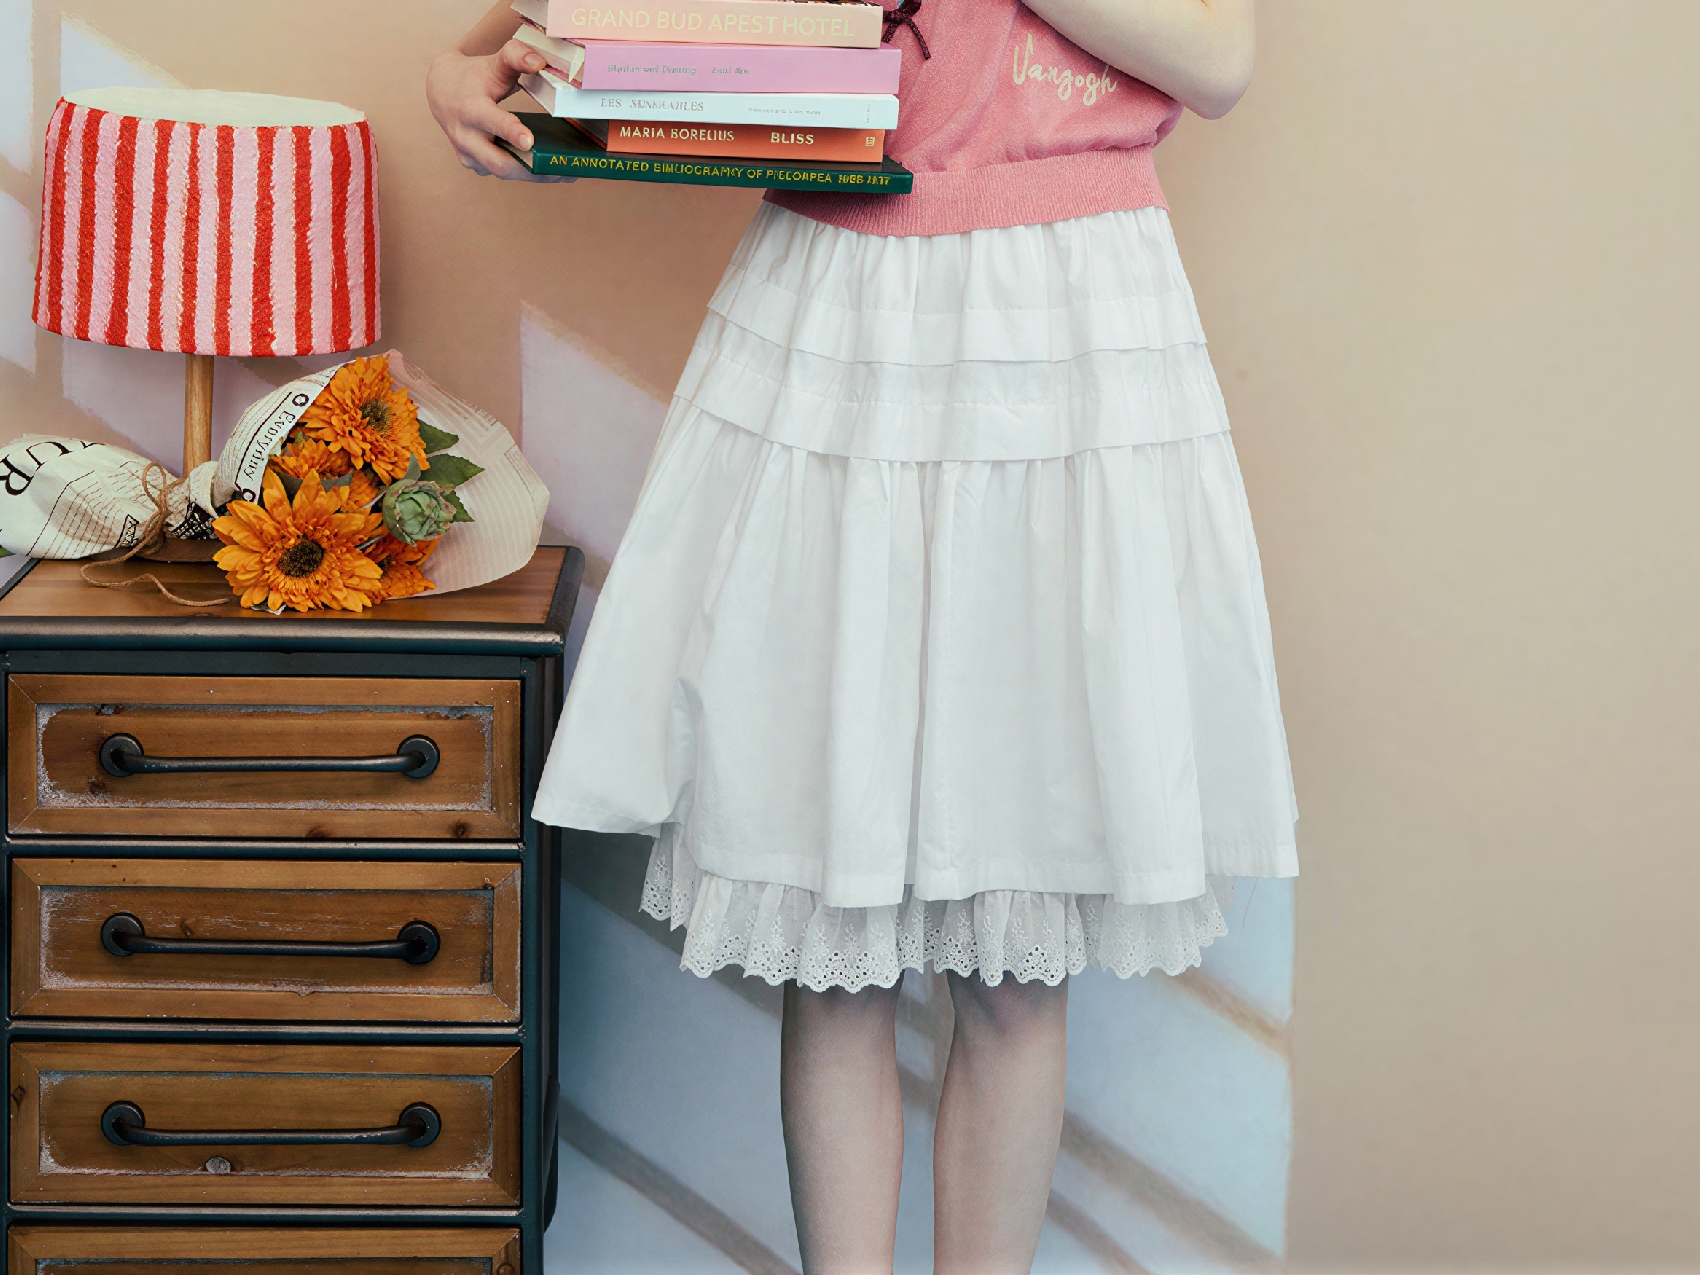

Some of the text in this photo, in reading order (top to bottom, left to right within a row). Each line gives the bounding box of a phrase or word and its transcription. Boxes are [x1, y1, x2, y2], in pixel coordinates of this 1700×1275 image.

[571, 7, 653, 29] GRAND
[783, 14, 855, 37] HOTEL
[619, 126, 665, 139] MARIA
[770, 131, 815, 145] BLISS
[549, 155, 568, 166] AN
[571, 157, 650, 172] ANNOTATED
[746, 169, 763, 179] OF
[0, 440, 107, 496] UR
